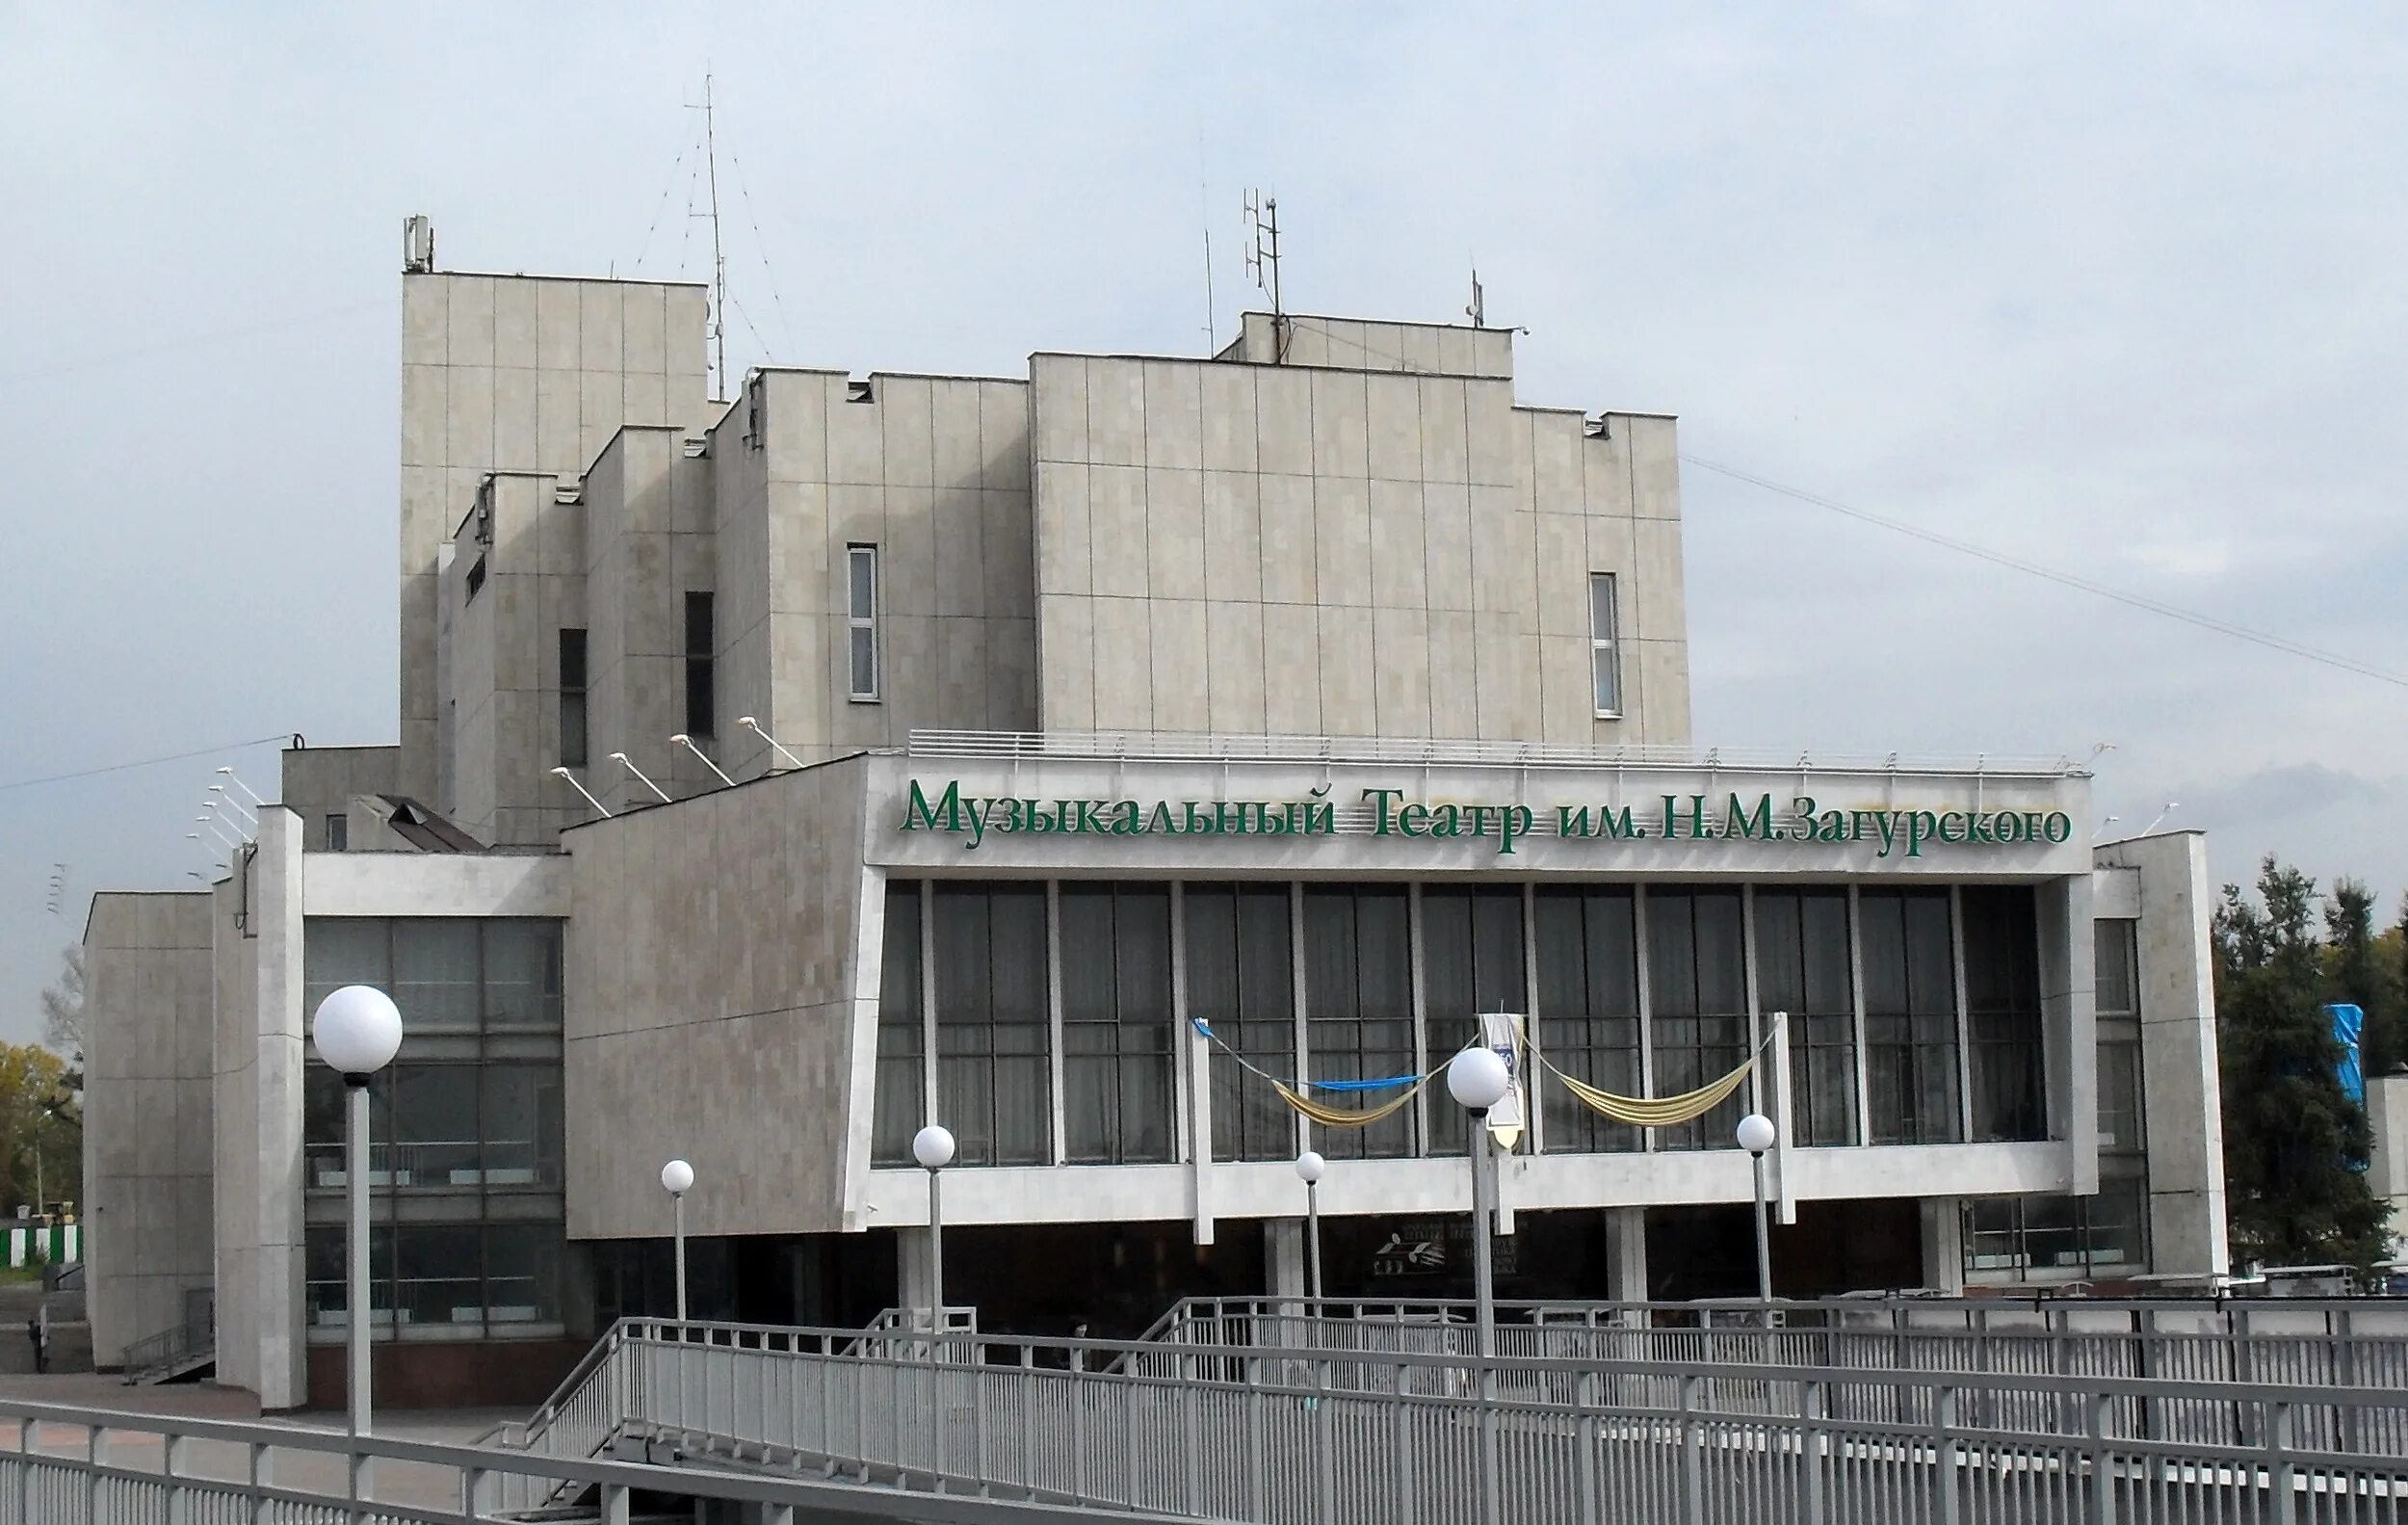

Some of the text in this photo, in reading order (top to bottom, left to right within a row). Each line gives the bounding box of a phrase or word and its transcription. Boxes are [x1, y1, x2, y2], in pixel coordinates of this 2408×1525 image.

[900, 779, 1337, 849] Музыкальный
[1361, 788, 1532, 854] Театр
[1557, 804, 1646, 839] им.
